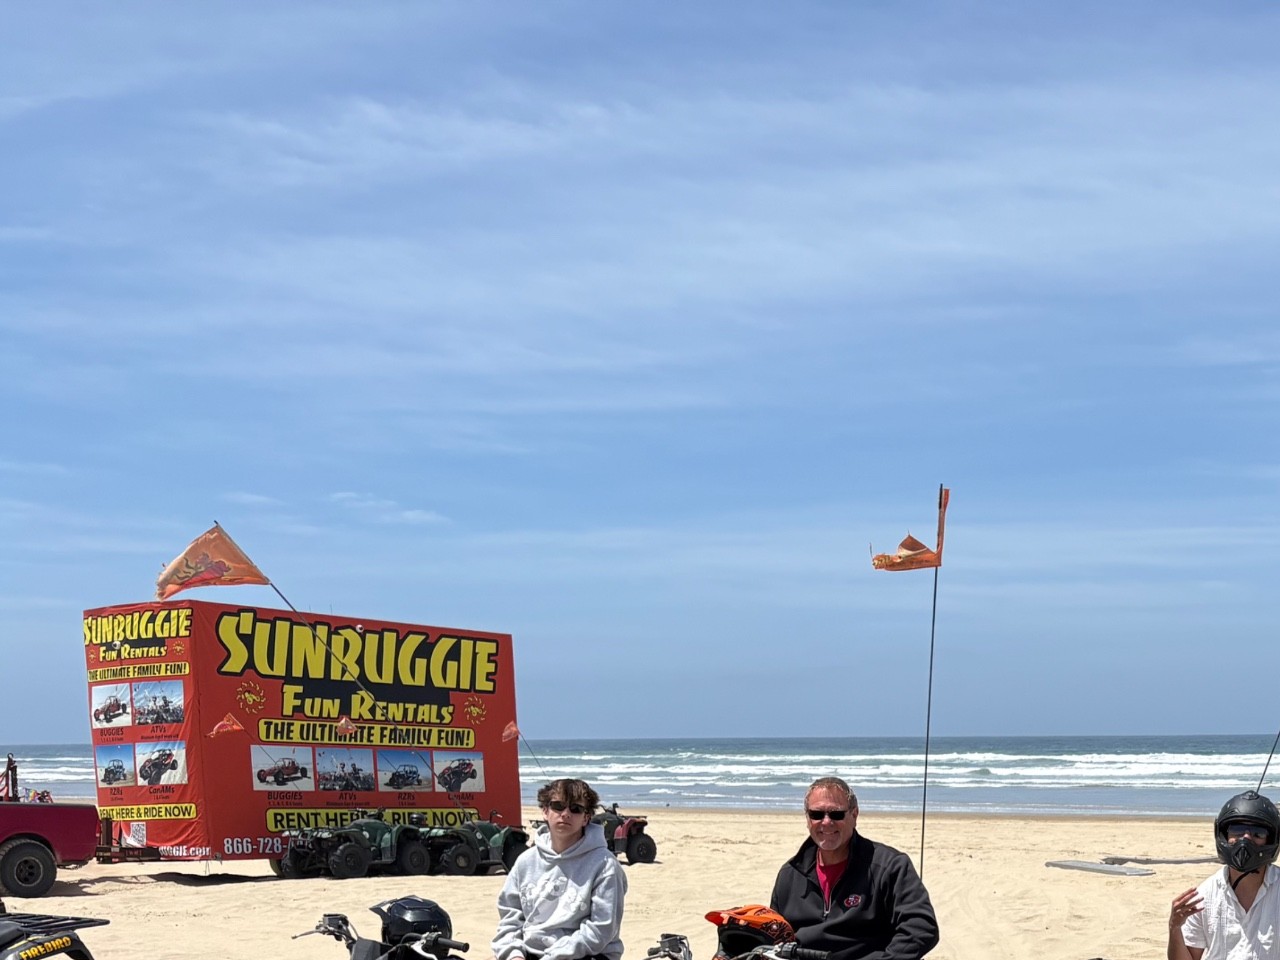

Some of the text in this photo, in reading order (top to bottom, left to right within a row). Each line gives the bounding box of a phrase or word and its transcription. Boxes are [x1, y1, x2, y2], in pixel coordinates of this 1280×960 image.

[84, 609, 192, 645] SUNBUGGIE
[218, 612, 498, 692] SUNBUGGIE
[100, 666, 130, 679] ULTIMATE
[133, 664, 162, 676] FAMILY
[165, 663, 187, 674] FUN!
[264, 721, 294, 740] THE
[376, 727, 432, 745] FAMILY
[438, 729, 470, 746] FUN!
[267, 791, 303, 800] BUGGIES
[116, 808, 135, 818] HERE
[136, 808, 142, 818] &
[144, 807, 162, 817] RIDE
[165, 805, 192, 817] NOW
[274, 812, 321, 829] RENT
[223, 837, 289, 855] 866-728-
[20, 936, 72, 960] FIREBIRD
